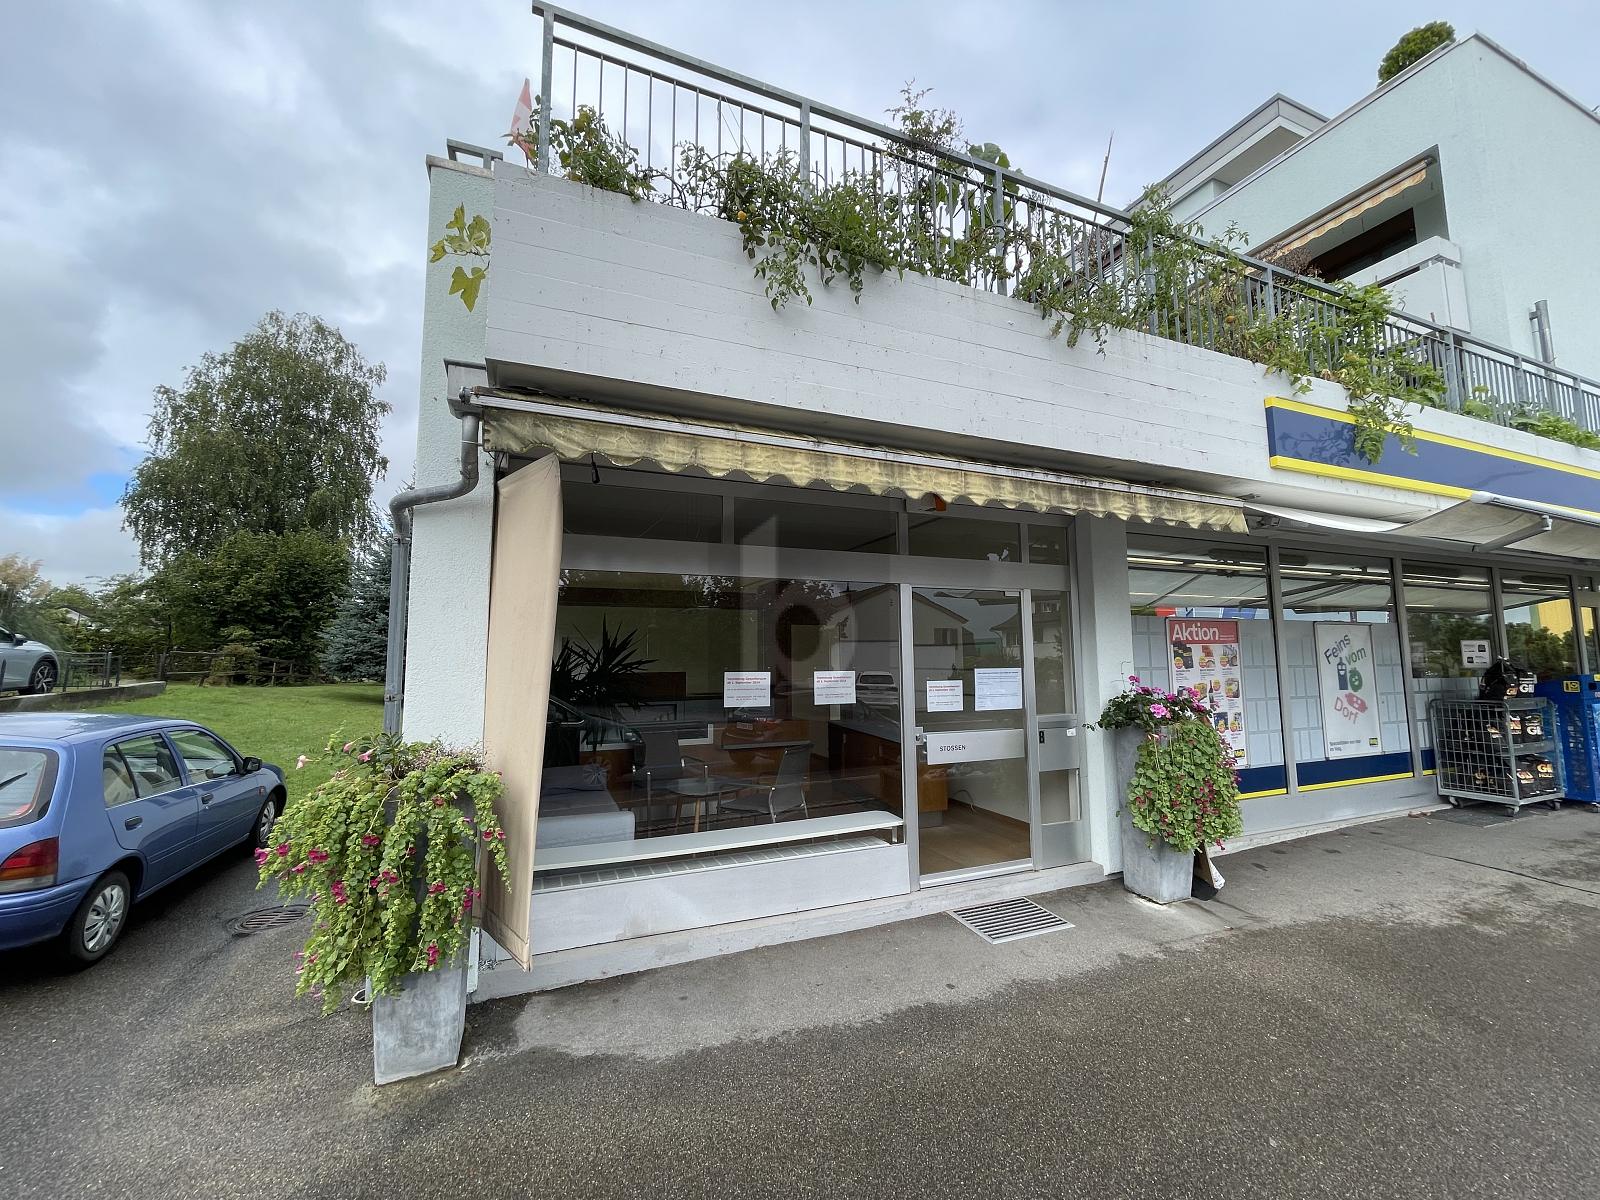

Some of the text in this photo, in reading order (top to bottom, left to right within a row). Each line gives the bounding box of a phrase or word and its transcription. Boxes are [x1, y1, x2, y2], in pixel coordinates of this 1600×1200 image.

[1172, 622, 1219, 641] Aktion
[1324, 634, 1351, 665] Feins
[1345, 647, 1367, 666] vom
[1334, 696, 1359, 725] Dorf
[939, 744, 966, 752] STOSSEN
